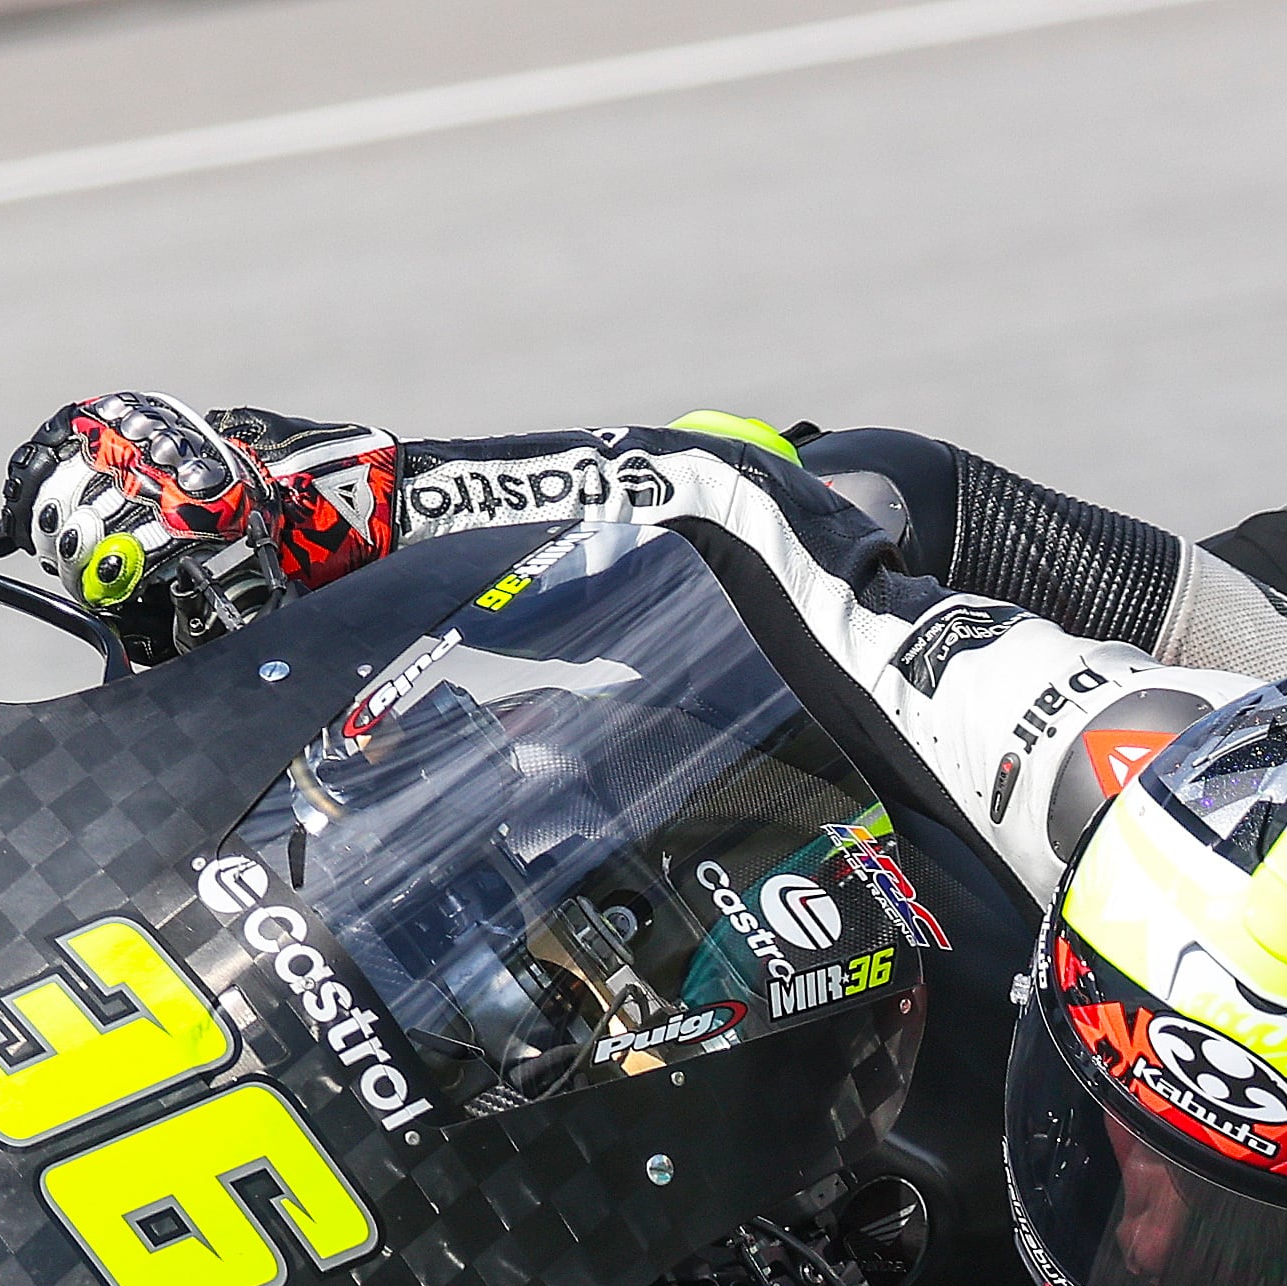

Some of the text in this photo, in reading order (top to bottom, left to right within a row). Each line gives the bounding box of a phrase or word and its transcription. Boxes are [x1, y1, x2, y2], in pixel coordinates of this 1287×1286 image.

[821, 822, 953, 952] HRC
[243, 904, 436, 1134] Castrol
[592, 1007, 717, 1065] Puig
[1131, 1057, 1280, 1157] Kabuto
